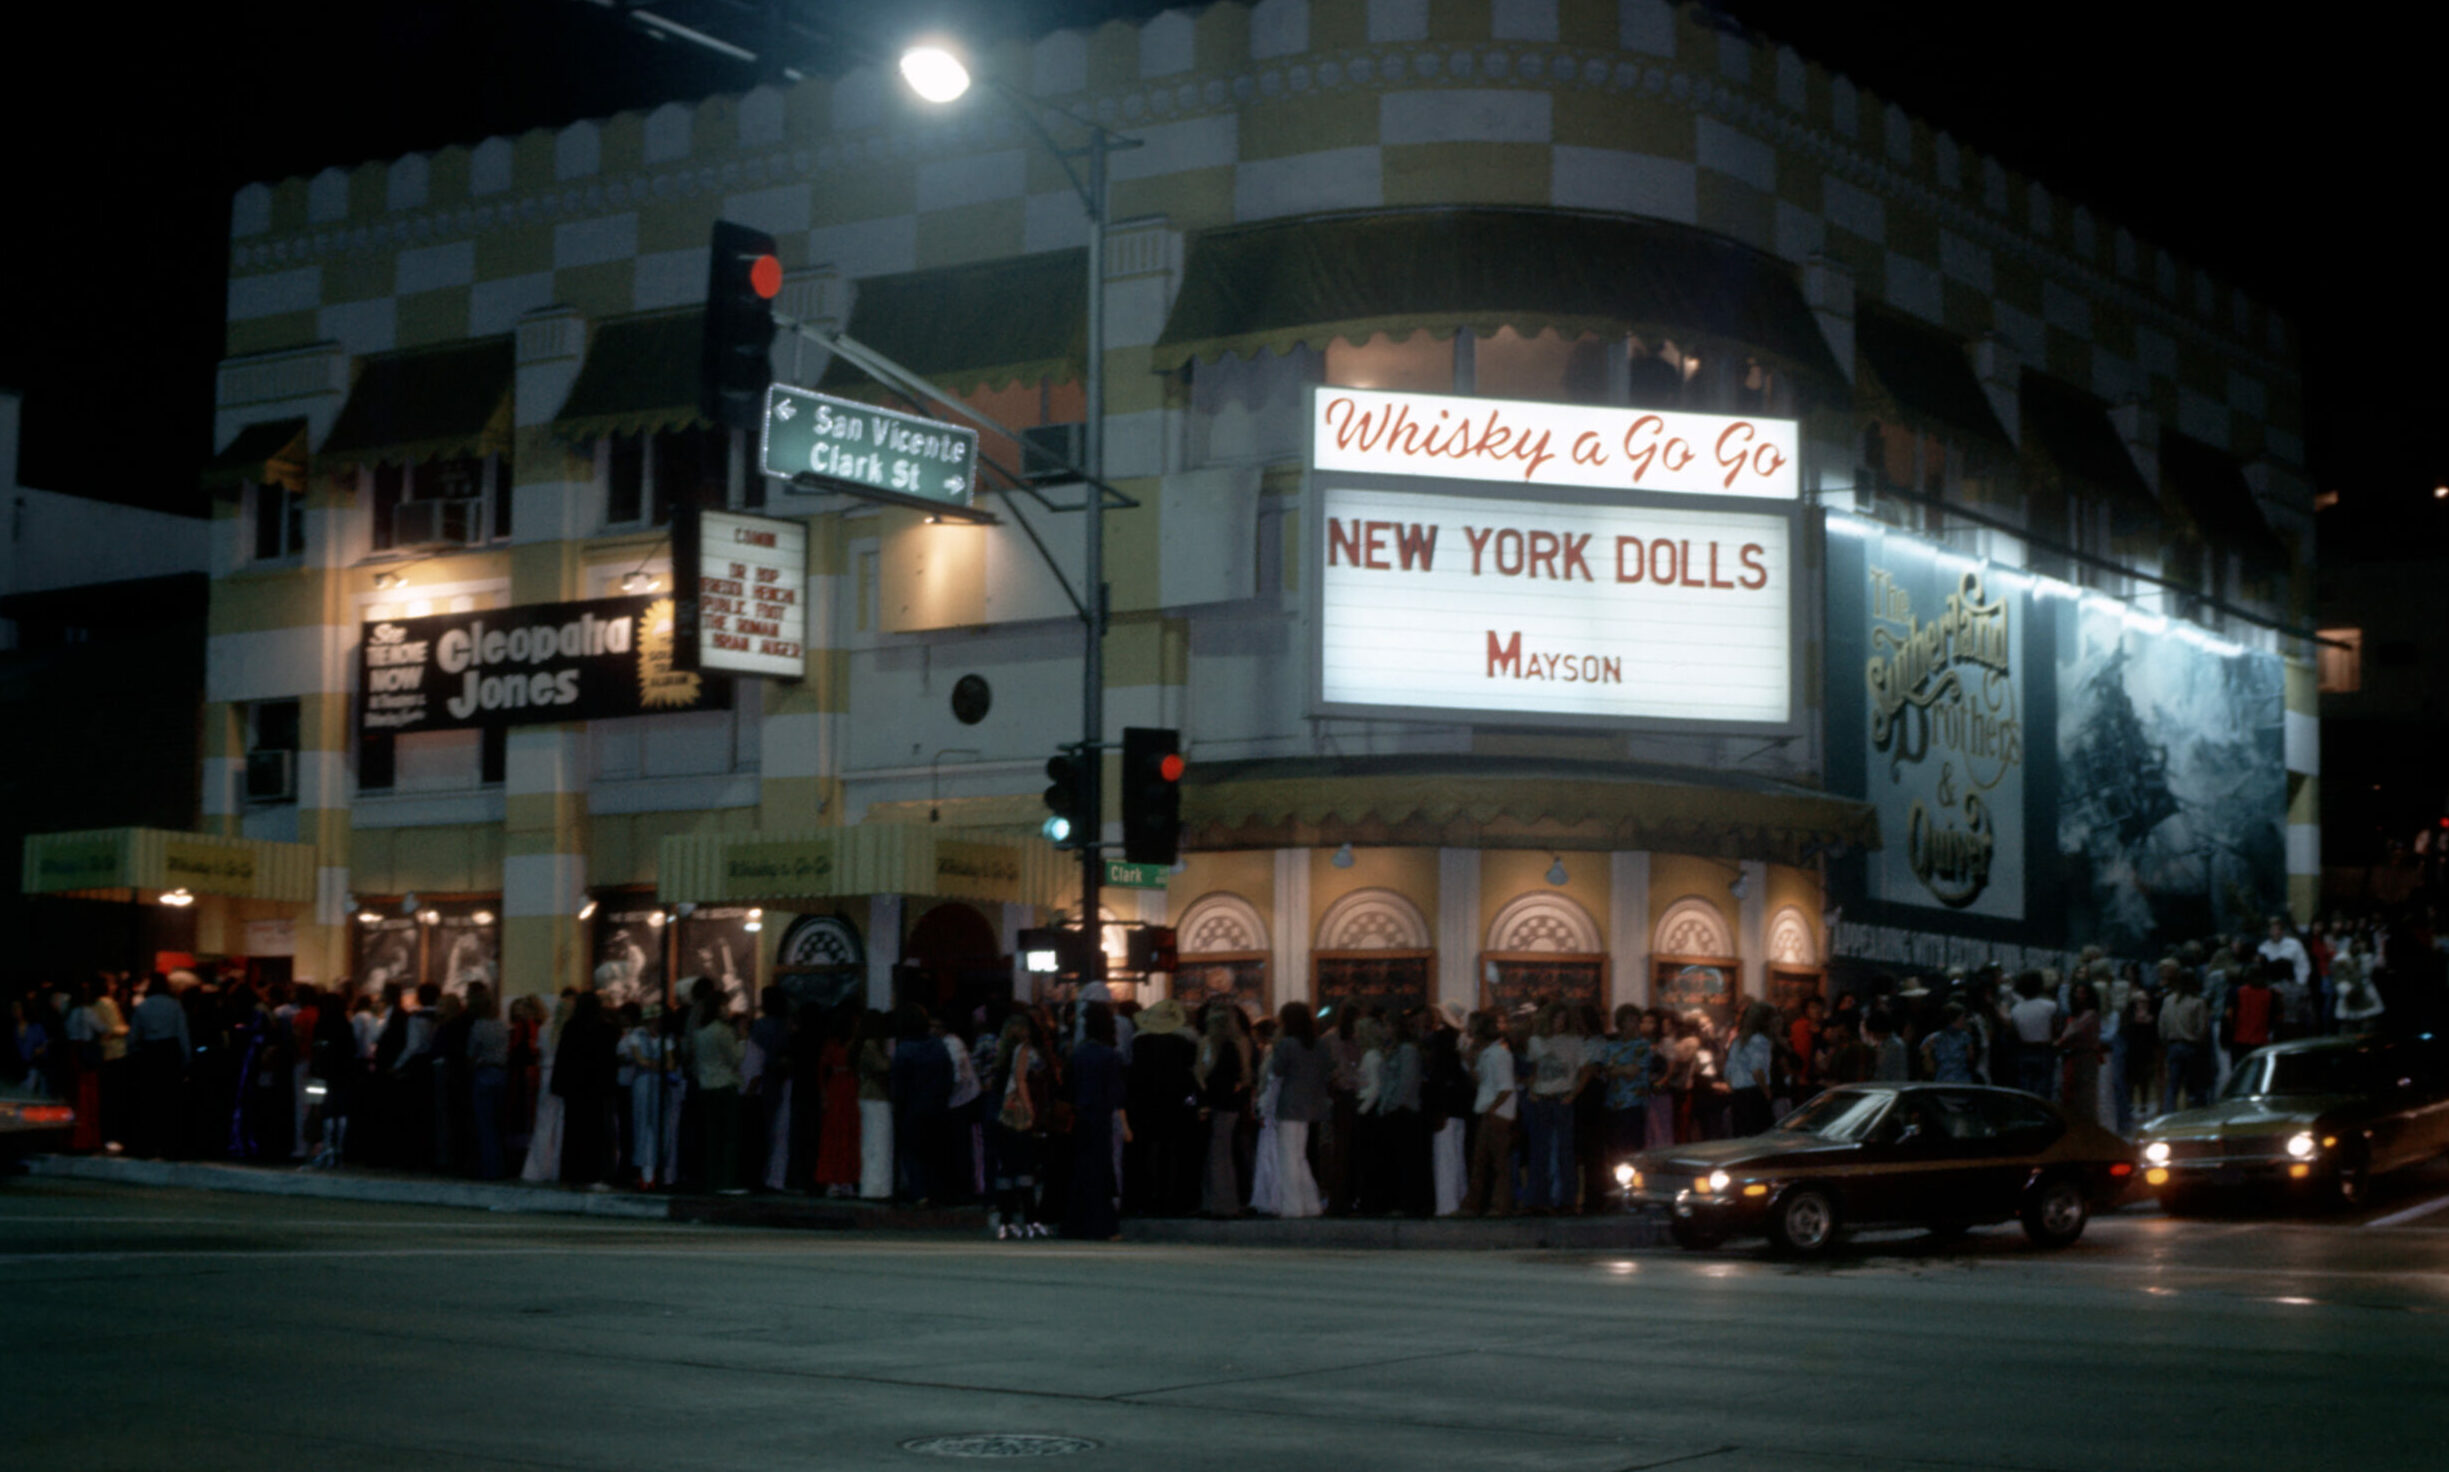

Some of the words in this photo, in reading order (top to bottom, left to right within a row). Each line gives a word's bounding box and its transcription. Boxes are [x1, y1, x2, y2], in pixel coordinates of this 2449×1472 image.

[813, 405, 864, 444] San
[871, 418, 966, 464] Vicente
[1325, 397, 1555, 481] Whisky
[1571, 430, 1609, 467] a
[1623, 414, 1695, 482] Go
[1714, 421, 1786, 488] Go
[810, 445, 884, 485] Clark
[890, 460, 921, 491] St
[1328, 517, 1438, 571] NEW
[1464, 526, 1594, 582] YORK
[1616, 535, 1768, 590] DOLLS
[1869, 569, 1911, 622] The
[436, 613, 632, 675] Cleopatra
[1867, 573, 2010, 750] Sutherland
[368, 665, 425, 693] NOW
[446, 667, 580, 720] Jones
[1892, 670, 2022, 790] Brothers
[1938, 762, 1957, 808] &
[1111, 864, 1143, 883] Clark
[1909, 793, 1993, 908] Quiver
